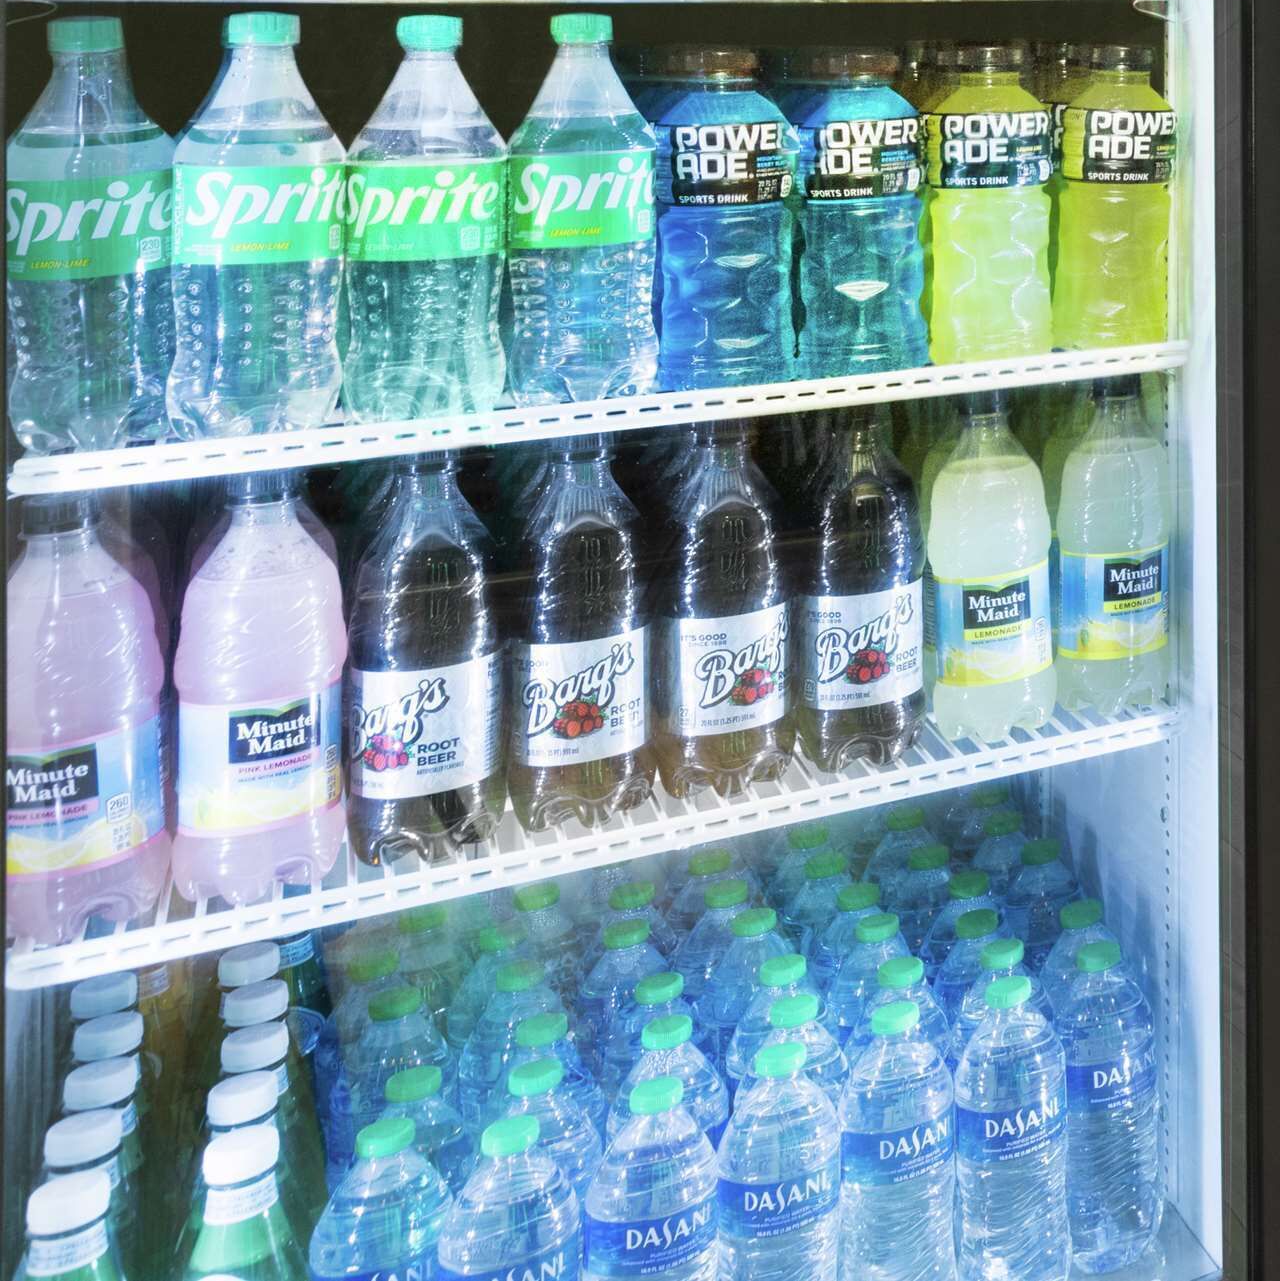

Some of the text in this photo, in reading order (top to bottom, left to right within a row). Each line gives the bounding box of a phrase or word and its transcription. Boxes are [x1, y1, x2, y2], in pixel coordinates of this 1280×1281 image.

[945, 111, 1048, 136] POWER
[945, 138, 1013, 162] ADE
[1089, 137, 1152, 160] ADE
[677, 151, 753, 180] ADE
[1089, 172, 1149, 182] SPORTS DRINK
[946, 177, 1009, 187] SPORTS DRINK
[346, 166, 499, 239] Sprite
[679, 194, 748, 205] SPORTS DRINK
[6, 179, 175, 255] Sprite
[1110, 564, 1159, 583] Minute
[1118, 578, 1153, 595] Maid
[969, 591, 1026, 610] Minute
[1114, 596, 1155, 610] LEMONADE
[977, 604, 1018, 623] Maid
[818, 591, 913, 683] Barq's
[975, 624, 1022, 638] LEMONADE
[522, 639, 635, 735] Barq's
[237, 716, 312, 740] Minute
[248, 732, 307, 755] Maid
[417, 739, 460, 755] ROOT
[416, 752, 456, 767] BEER
[6, 761, 89, 785] Minute
[14, 780, 76, 803] Maid
[986, 1096, 1059, 1139] DASANI
[745, 1174, 830, 1211] DASANI
